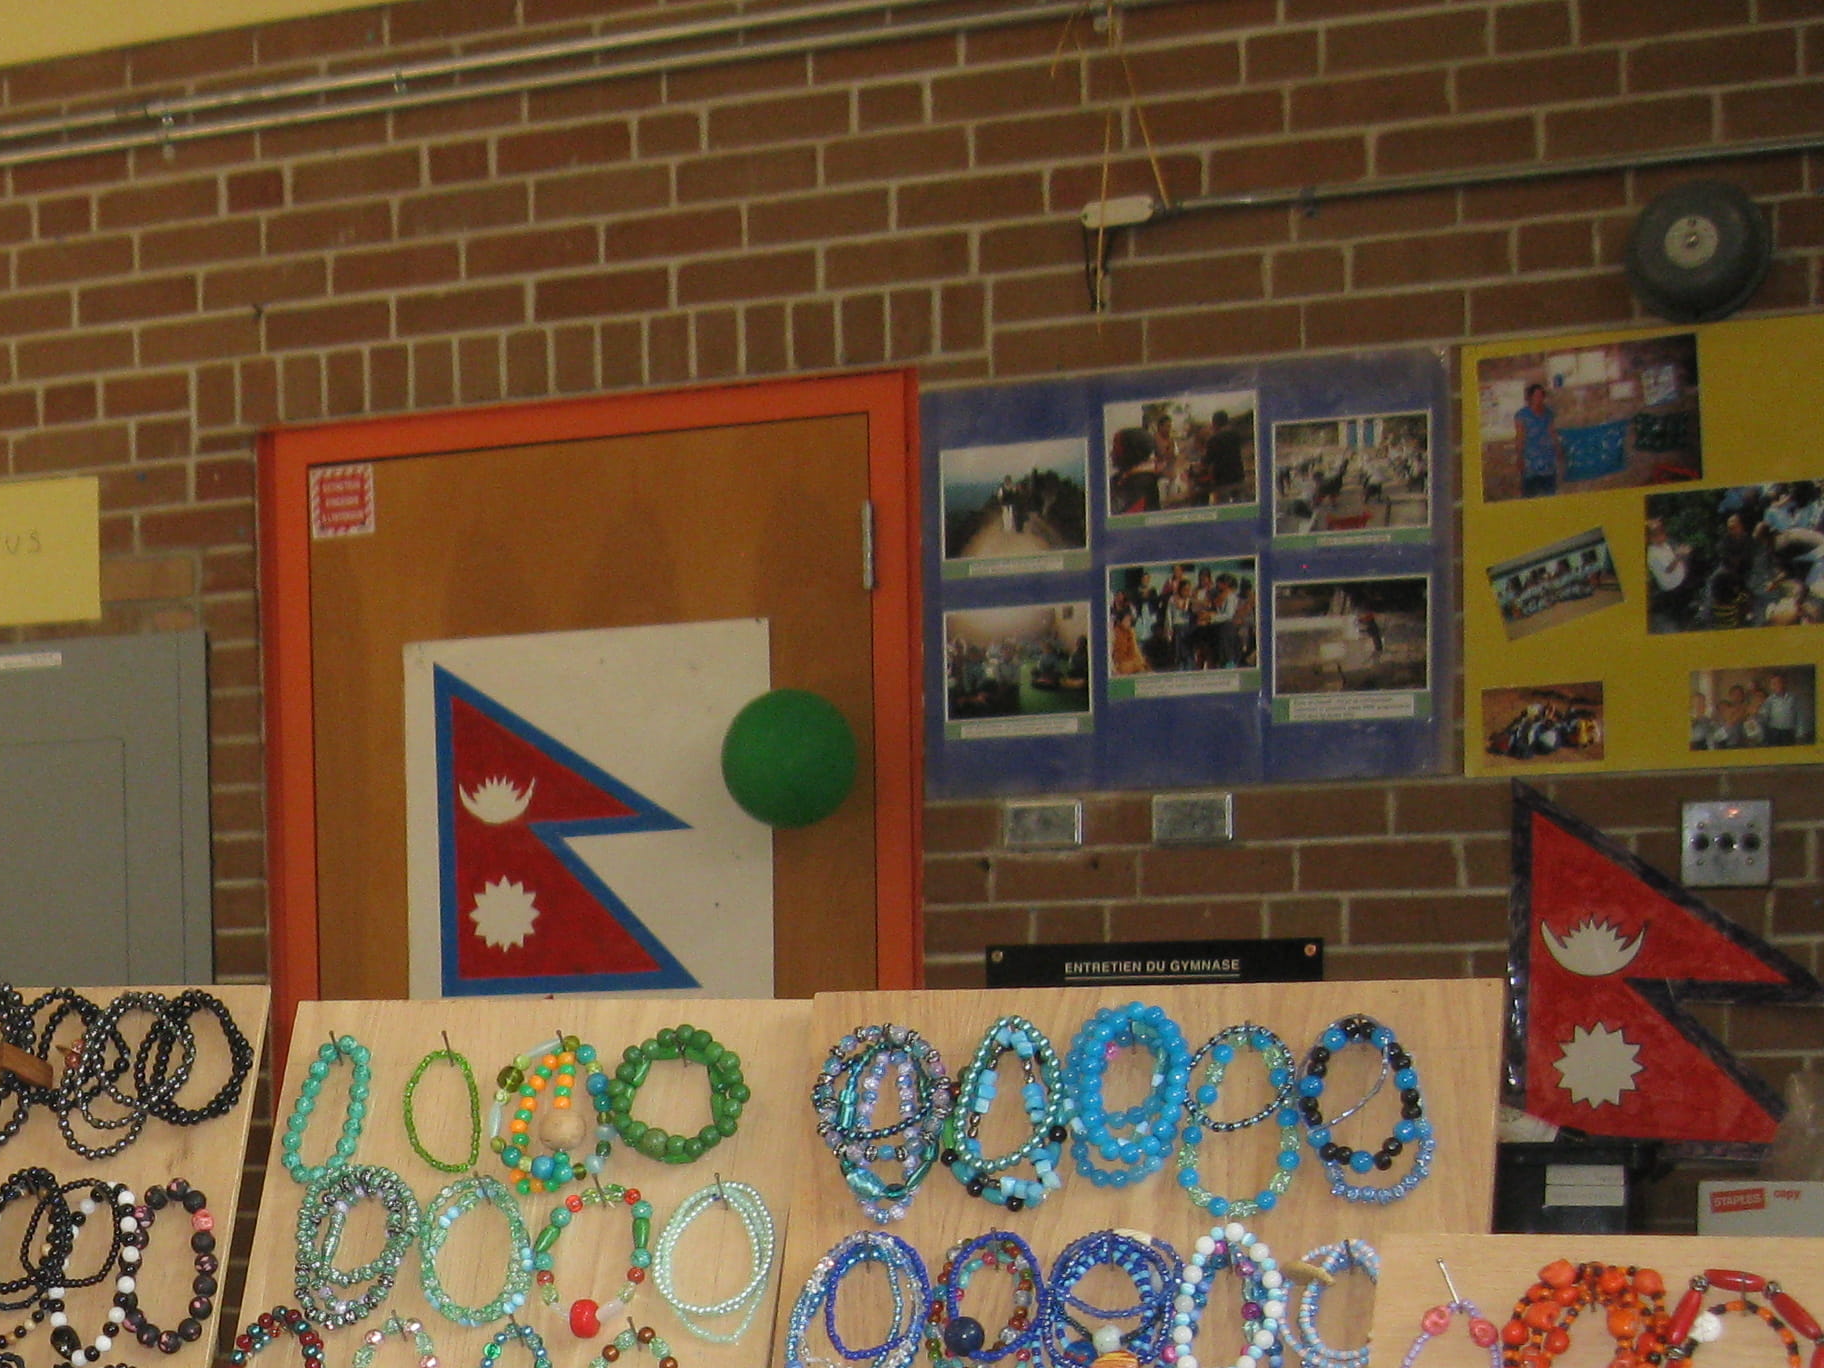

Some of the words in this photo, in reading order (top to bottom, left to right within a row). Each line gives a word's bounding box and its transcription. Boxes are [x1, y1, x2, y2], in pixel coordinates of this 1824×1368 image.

[1064, 960, 1142, 975] ENTRETIEN
[1146, 960, 1166, 974] DU
[1170, 958, 1241, 973] GYMNASE
[1713, 1193, 1764, 1208] STAPLES
